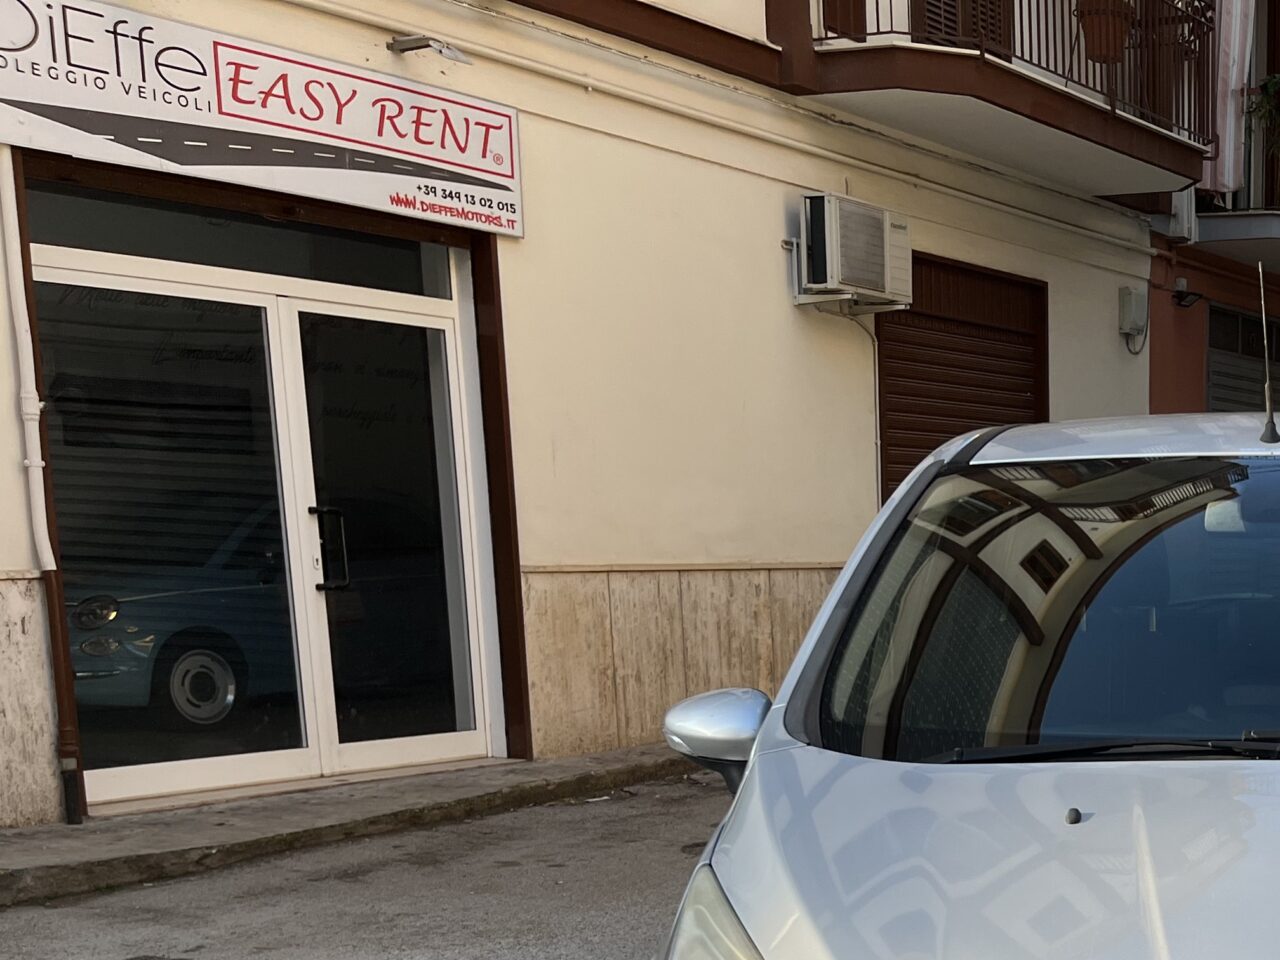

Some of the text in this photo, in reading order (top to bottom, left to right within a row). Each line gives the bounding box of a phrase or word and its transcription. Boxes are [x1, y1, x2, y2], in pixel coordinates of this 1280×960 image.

[121, 81, 212, 113] VEICOLI
[226, 61, 358, 125] EASY
[416, 184, 517, 214] +39 349 13 02 015
